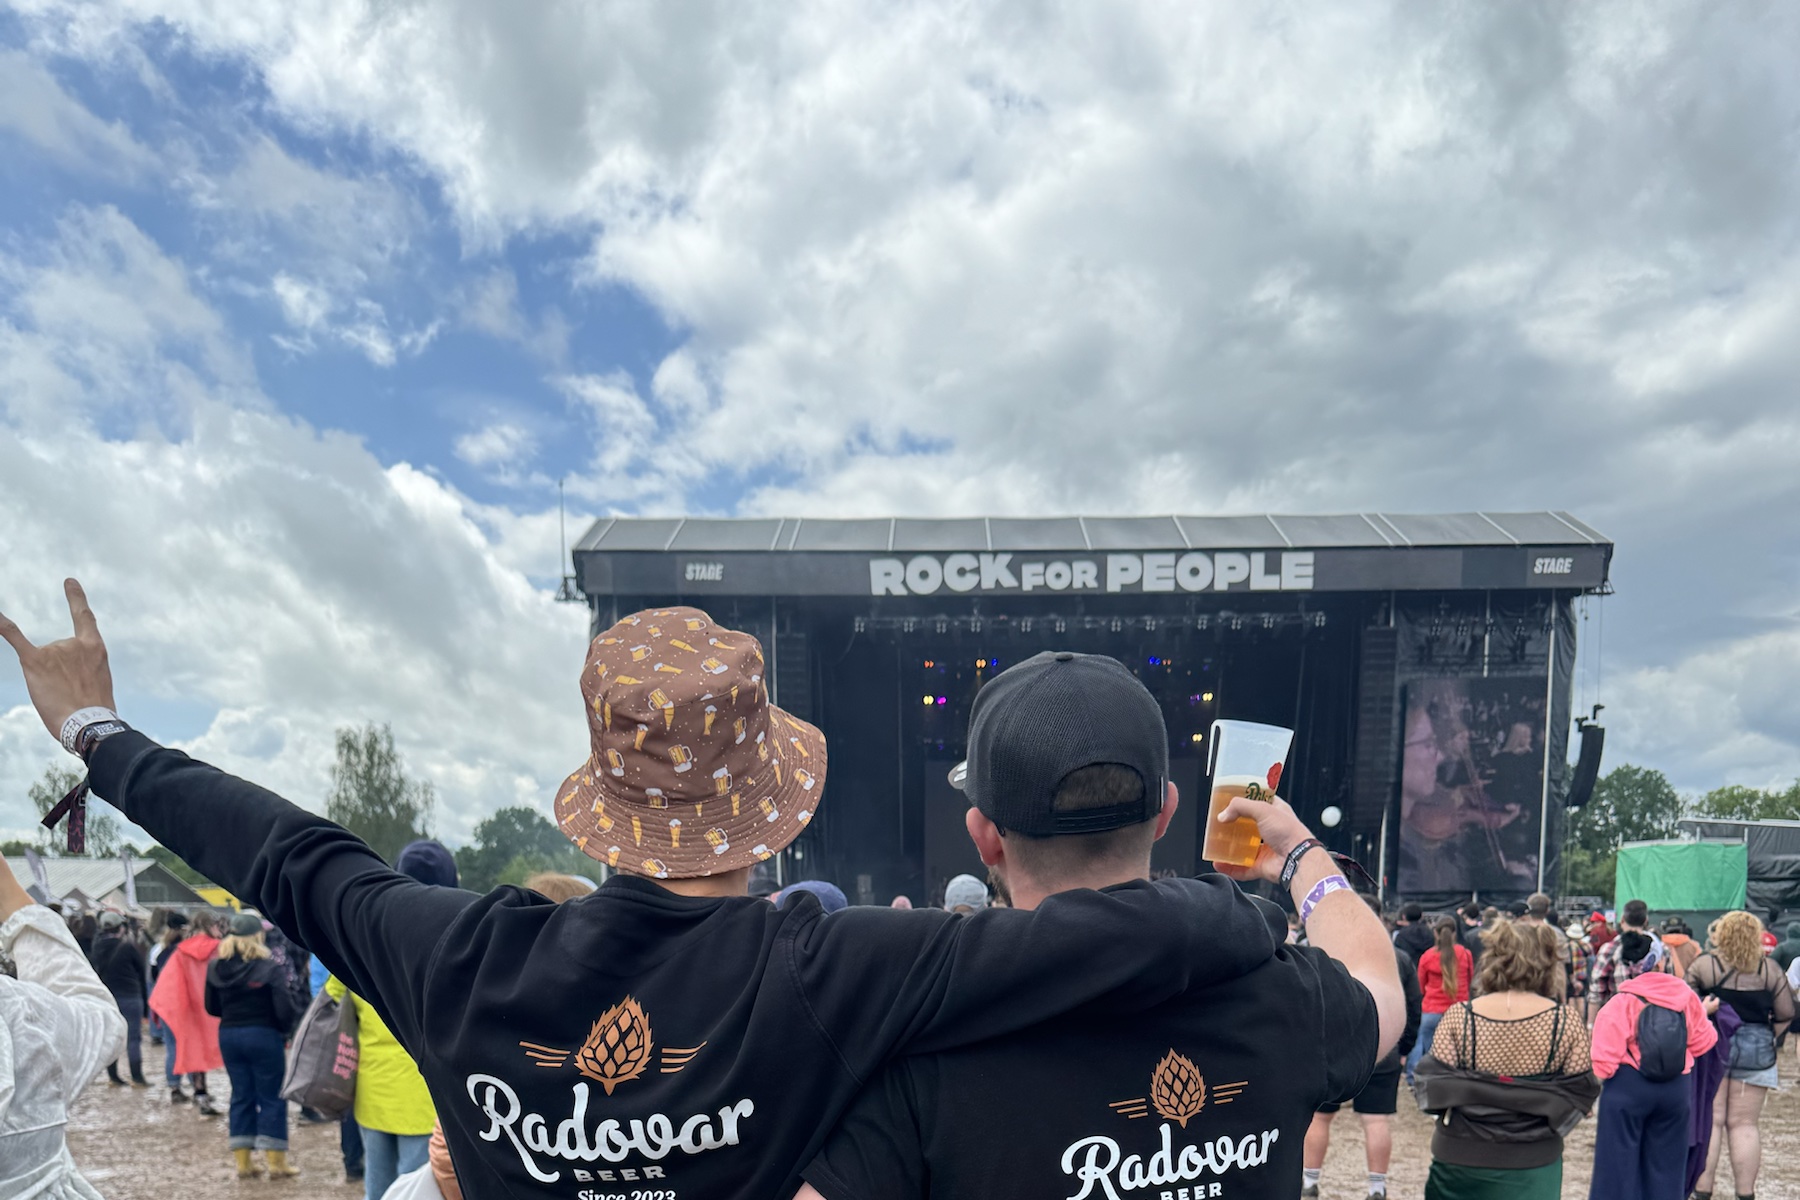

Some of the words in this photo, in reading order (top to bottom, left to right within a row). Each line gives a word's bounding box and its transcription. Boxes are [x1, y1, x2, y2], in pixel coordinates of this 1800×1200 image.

[685, 562, 724, 581] STAGE
[869, 553, 1019, 596] ROCK
[1021, 560, 1099, 591] FOR
[1106, 551, 1315, 593] PEOPLE
[1533, 557, 1574, 574] STAGE
[466, 1073, 755, 1184] Radovar
[573, 1165, 666, 1183] BEER
